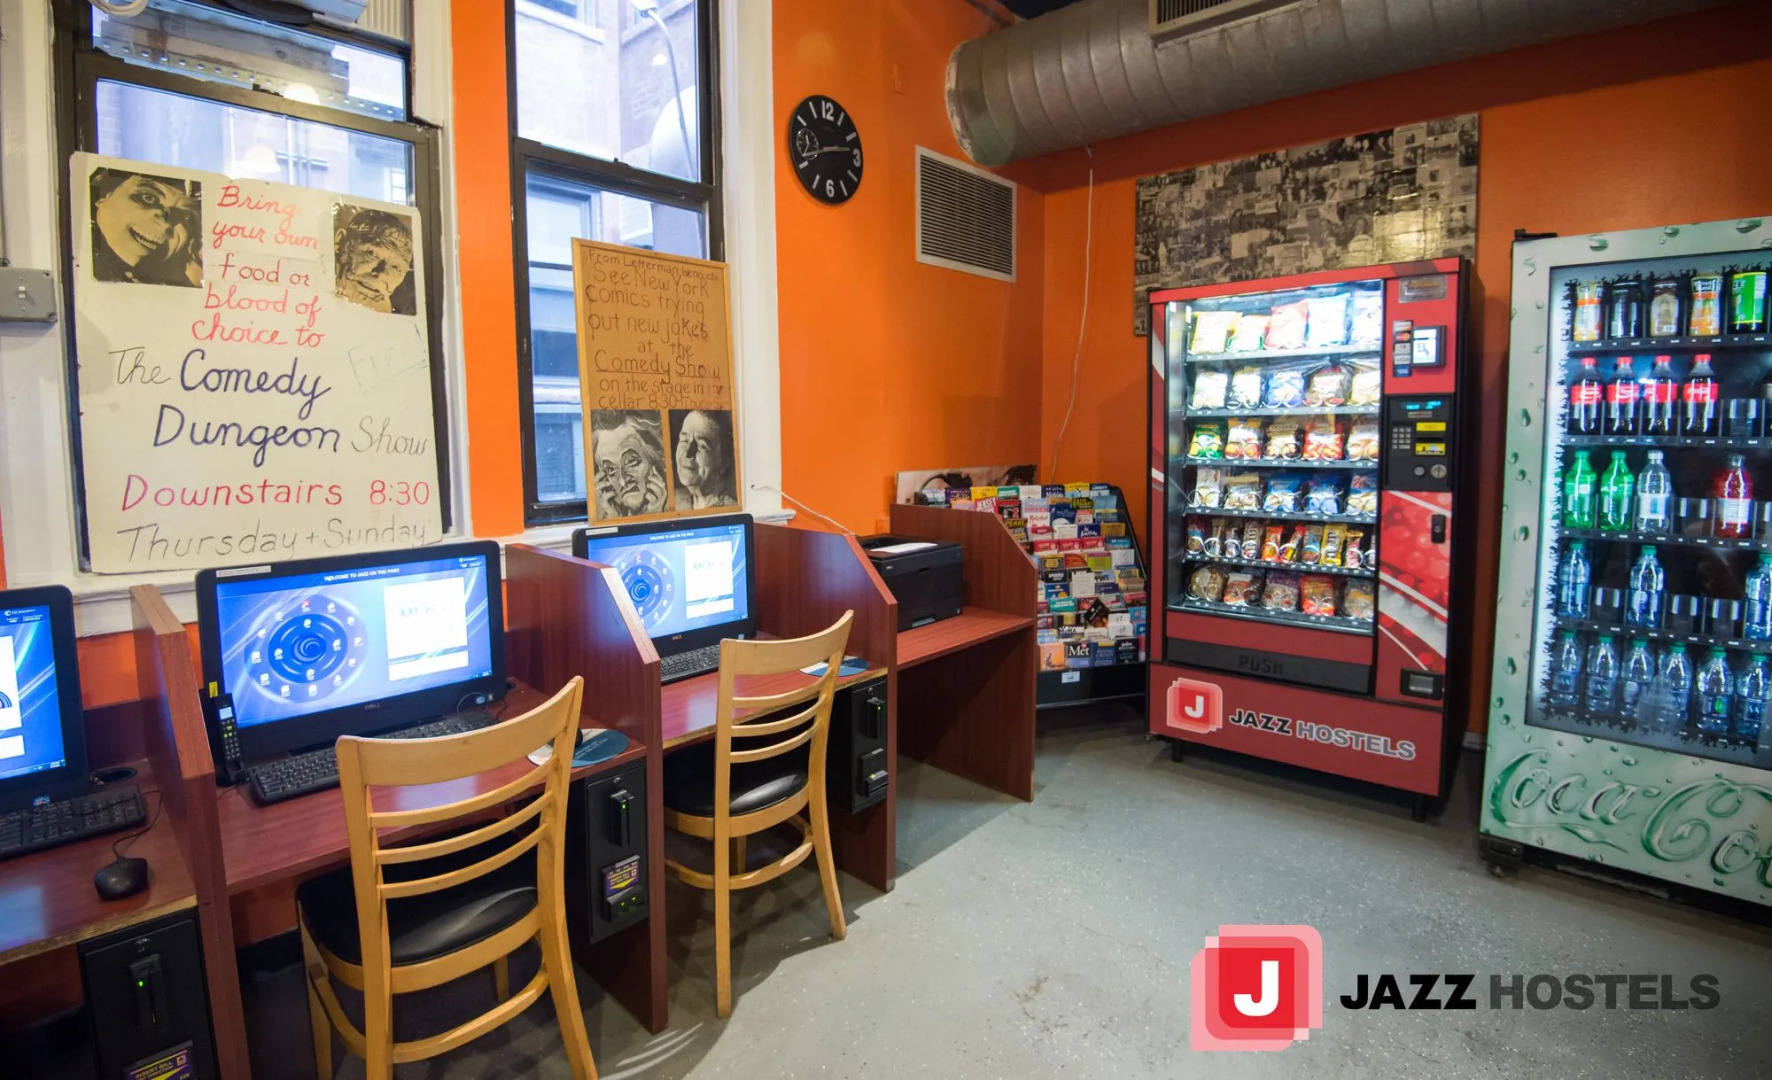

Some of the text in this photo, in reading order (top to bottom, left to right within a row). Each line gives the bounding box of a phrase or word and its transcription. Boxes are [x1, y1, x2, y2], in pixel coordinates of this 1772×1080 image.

[822, 100, 835, 121] 12
[852, 148, 861, 168] 3
[825, 179, 835, 198] 6
[217, 185, 298, 228] Bring
[212, 219, 319, 251] your own
[218, 253, 312, 287] food or
[588, 248, 620, 265] From
[592, 261, 631, 286] See
[634, 267, 670, 291] New
[204, 284, 323, 327] blood of
[659, 293, 705, 321] trying
[191, 318, 326, 348] choice to
[627, 316, 660, 334] new
[637, 336, 695, 358] at the
[594, 349, 671, 384] Comedy
[109, 346, 332, 420] The Comedy
[600, 378, 620, 391] on
[625, 374, 649, 392] the
[598, 392, 643, 409] cellar
[153, 403, 429, 467] Dungeon Show
[121, 474, 431, 512] Downstairs 8:30
[117, 519, 298, 563] Thursday
[326, 515, 427, 549] Sunday
[1068, 645, 1090, 656] Met
[1238, 654, 1285, 675] PUSH
[1184, 695, 1204, 718] J
[1229, 708, 1416, 761] JAZZ HOSTELS
